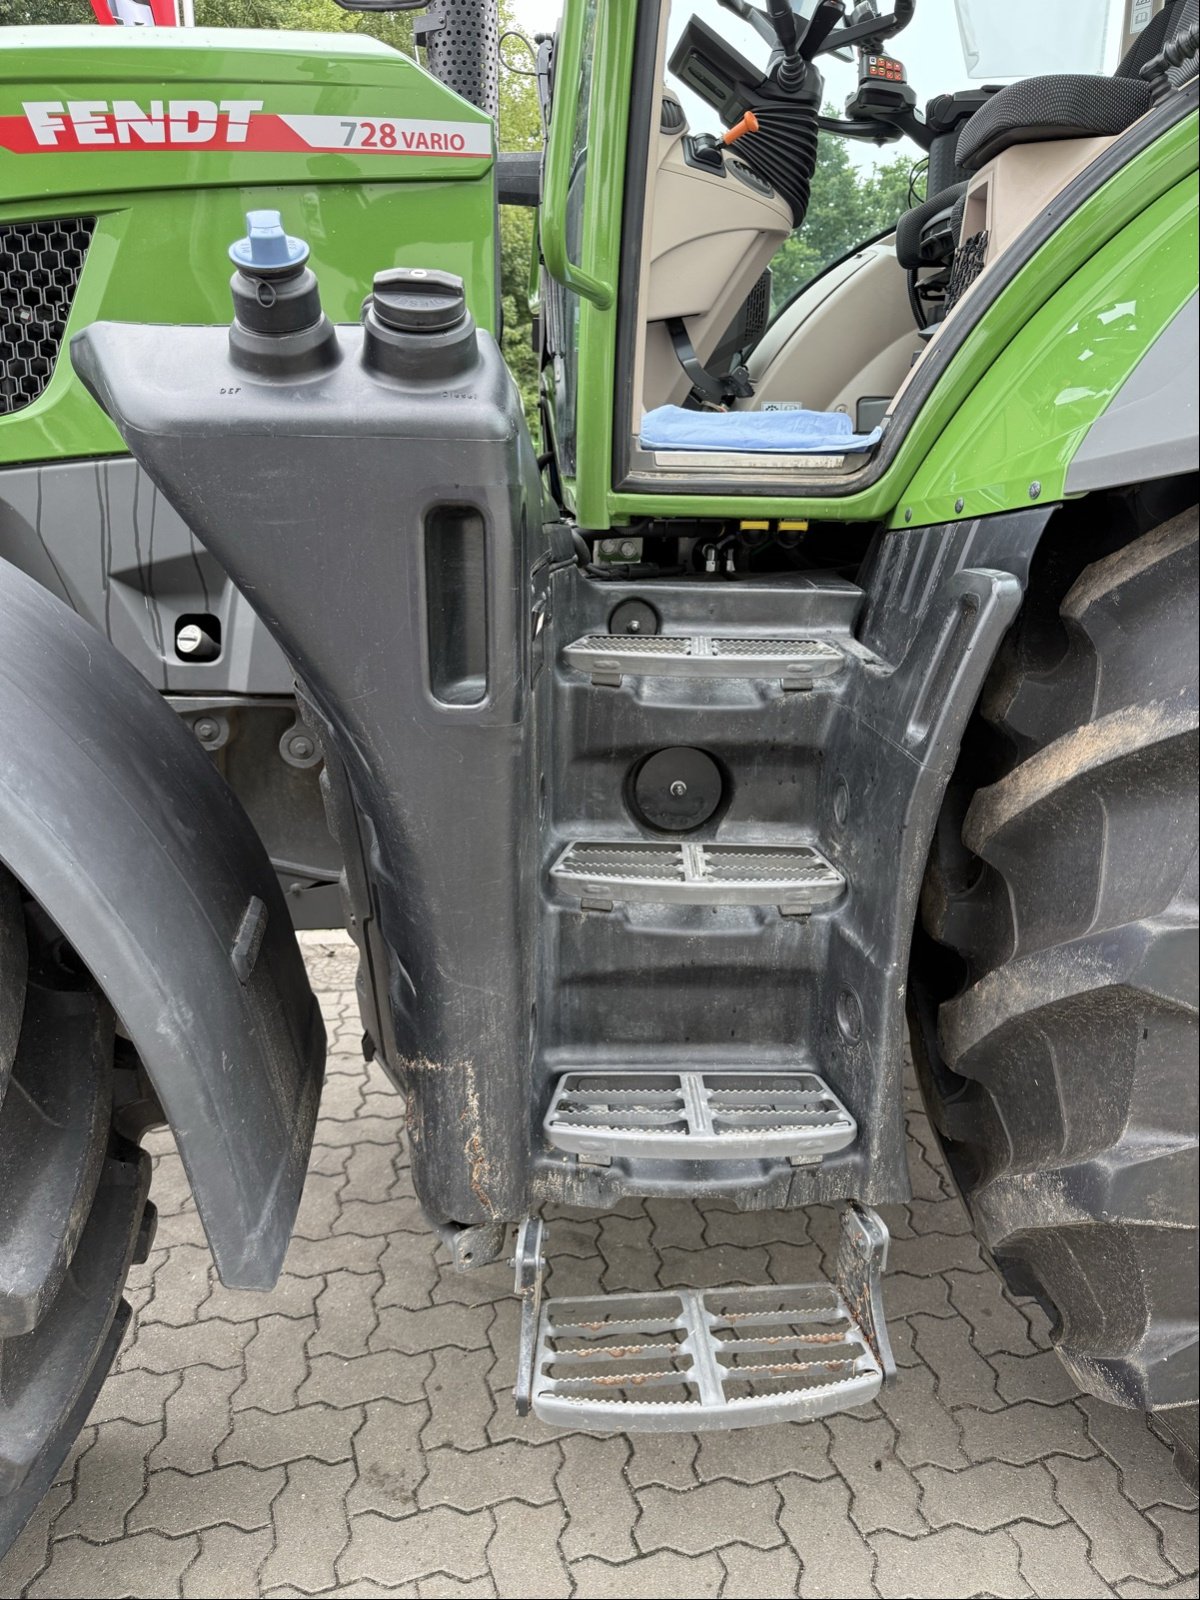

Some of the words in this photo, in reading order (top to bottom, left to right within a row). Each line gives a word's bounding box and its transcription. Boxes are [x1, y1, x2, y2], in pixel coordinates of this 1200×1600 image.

[21, 100, 264, 145] FENDT
[340, 121, 397, 148] 728
[401, 131, 465, 151] VARIO
